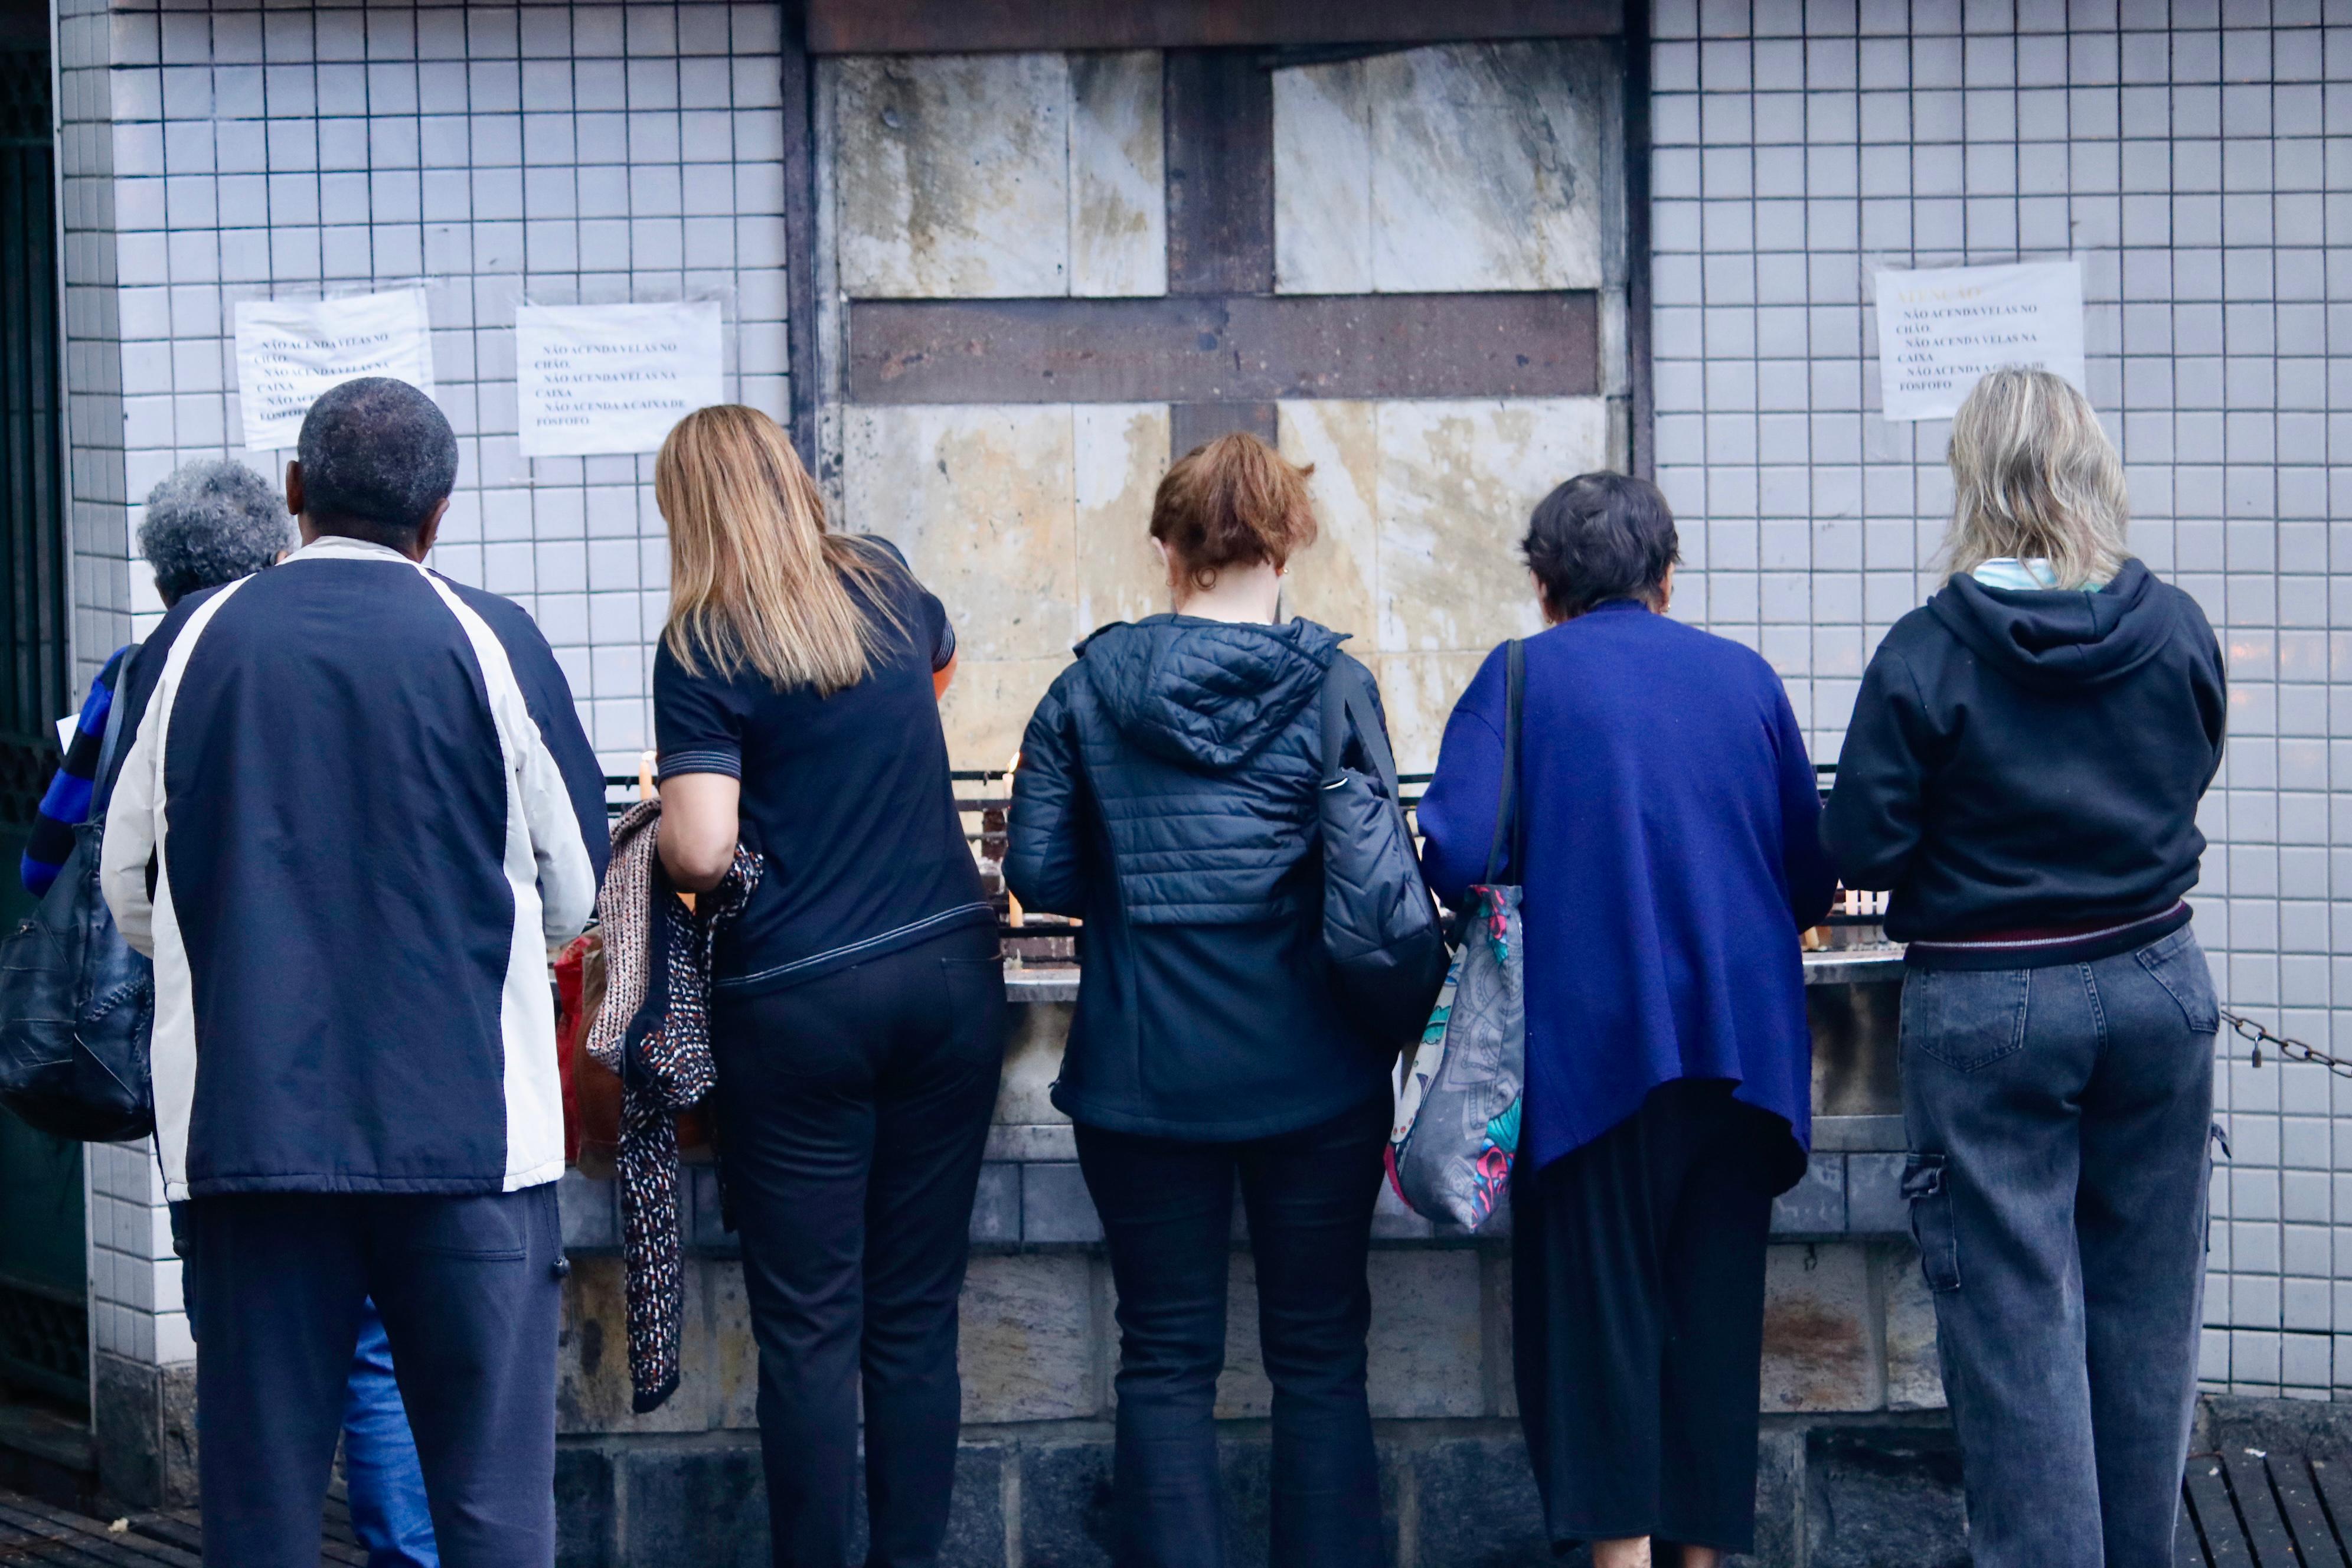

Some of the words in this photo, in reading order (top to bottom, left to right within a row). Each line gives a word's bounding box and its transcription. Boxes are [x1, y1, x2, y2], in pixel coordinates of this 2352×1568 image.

[1904, 308, 1928, 319] NÃO
[1932, 308, 1978, 318] ACENDA
[1981, 305, 2017, 315] VELAS
[2021, 304, 2037, 313] NO
[262, 339, 286, 350] NÃO
[374, 334, 388, 342] NO
[1906, 337, 1929, 348] NÃO
[1933, 336, 1979, 347] ACENDA
[1982, 334, 2018, 344] VELAS
[2021, 333, 2037, 342] NA
[543, 344, 567, 354] NÃO
[571, 345, 617, 354] ACENDA
[620, 344, 657, 353] VELAS
[661, 343, 677, 352] NO
[1897, 354, 1933, 363] CAIXA
[1907, 365, 1931, 377] NÃO
[1935, 364, 1980, 375] ACENDA
[544, 373, 569, 383] NÃO
[572, 373, 619, 383] ACENDA
[620, 371, 658, 381] VELAS
[661, 371, 677, 380] NA
[257, 383, 294, 393] CAIXA
[535, 388, 572, 398] CAIXA
[545, 401, 569, 411] NÃO
[573, 402, 619, 411] ACENDA
[631, 400, 668, 410] CAIXA
